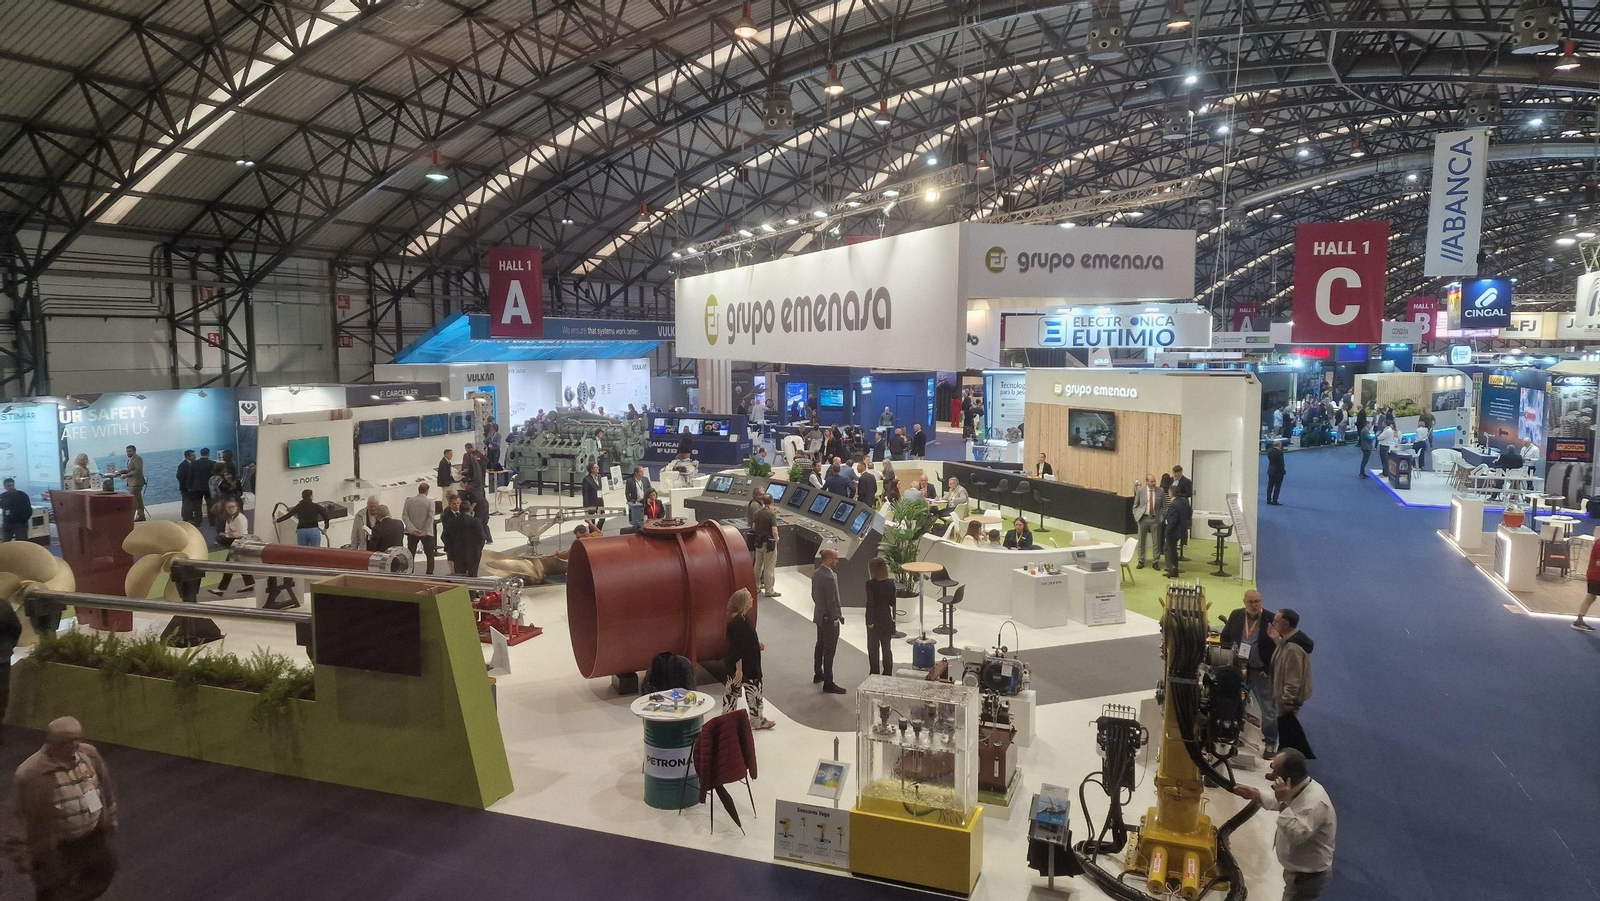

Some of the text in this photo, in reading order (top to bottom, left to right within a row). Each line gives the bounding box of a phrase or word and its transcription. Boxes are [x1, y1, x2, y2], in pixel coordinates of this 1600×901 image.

[1441, 136, 1474, 254] ABANCA
[1313, 241, 1370, 256] HALL 1
[499, 260, 532, 271] HALL 1
[1018, 252, 1164, 273] grupo emenasa
[501, 279, 532, 324] A
[1315, 267, 1362, 326] C
[727, 286, 891, 345] grupo emenasa
[1465, 309, 1507, 318] CINGAL
[562, 326, 570, 334] We
[597, 328, 615, 336] systems
[658, 326, 676, 337] VULK
[1240, 316, 1253, 332] A
[1414, 313, 1430, 335] B
[1073, 328, 1175, 347] EUTIMIO
[1000, 381, 1025, 391] Tecnolog
[1065, 384, 1137, 398] grupo emenasa
[60, 405, 148, 424] UR SAFETY
[61, 421, 149, 440] AFE WITH US
[300, 475, 320, 484] noris
[647, 754, 694, 768] PETRONA
